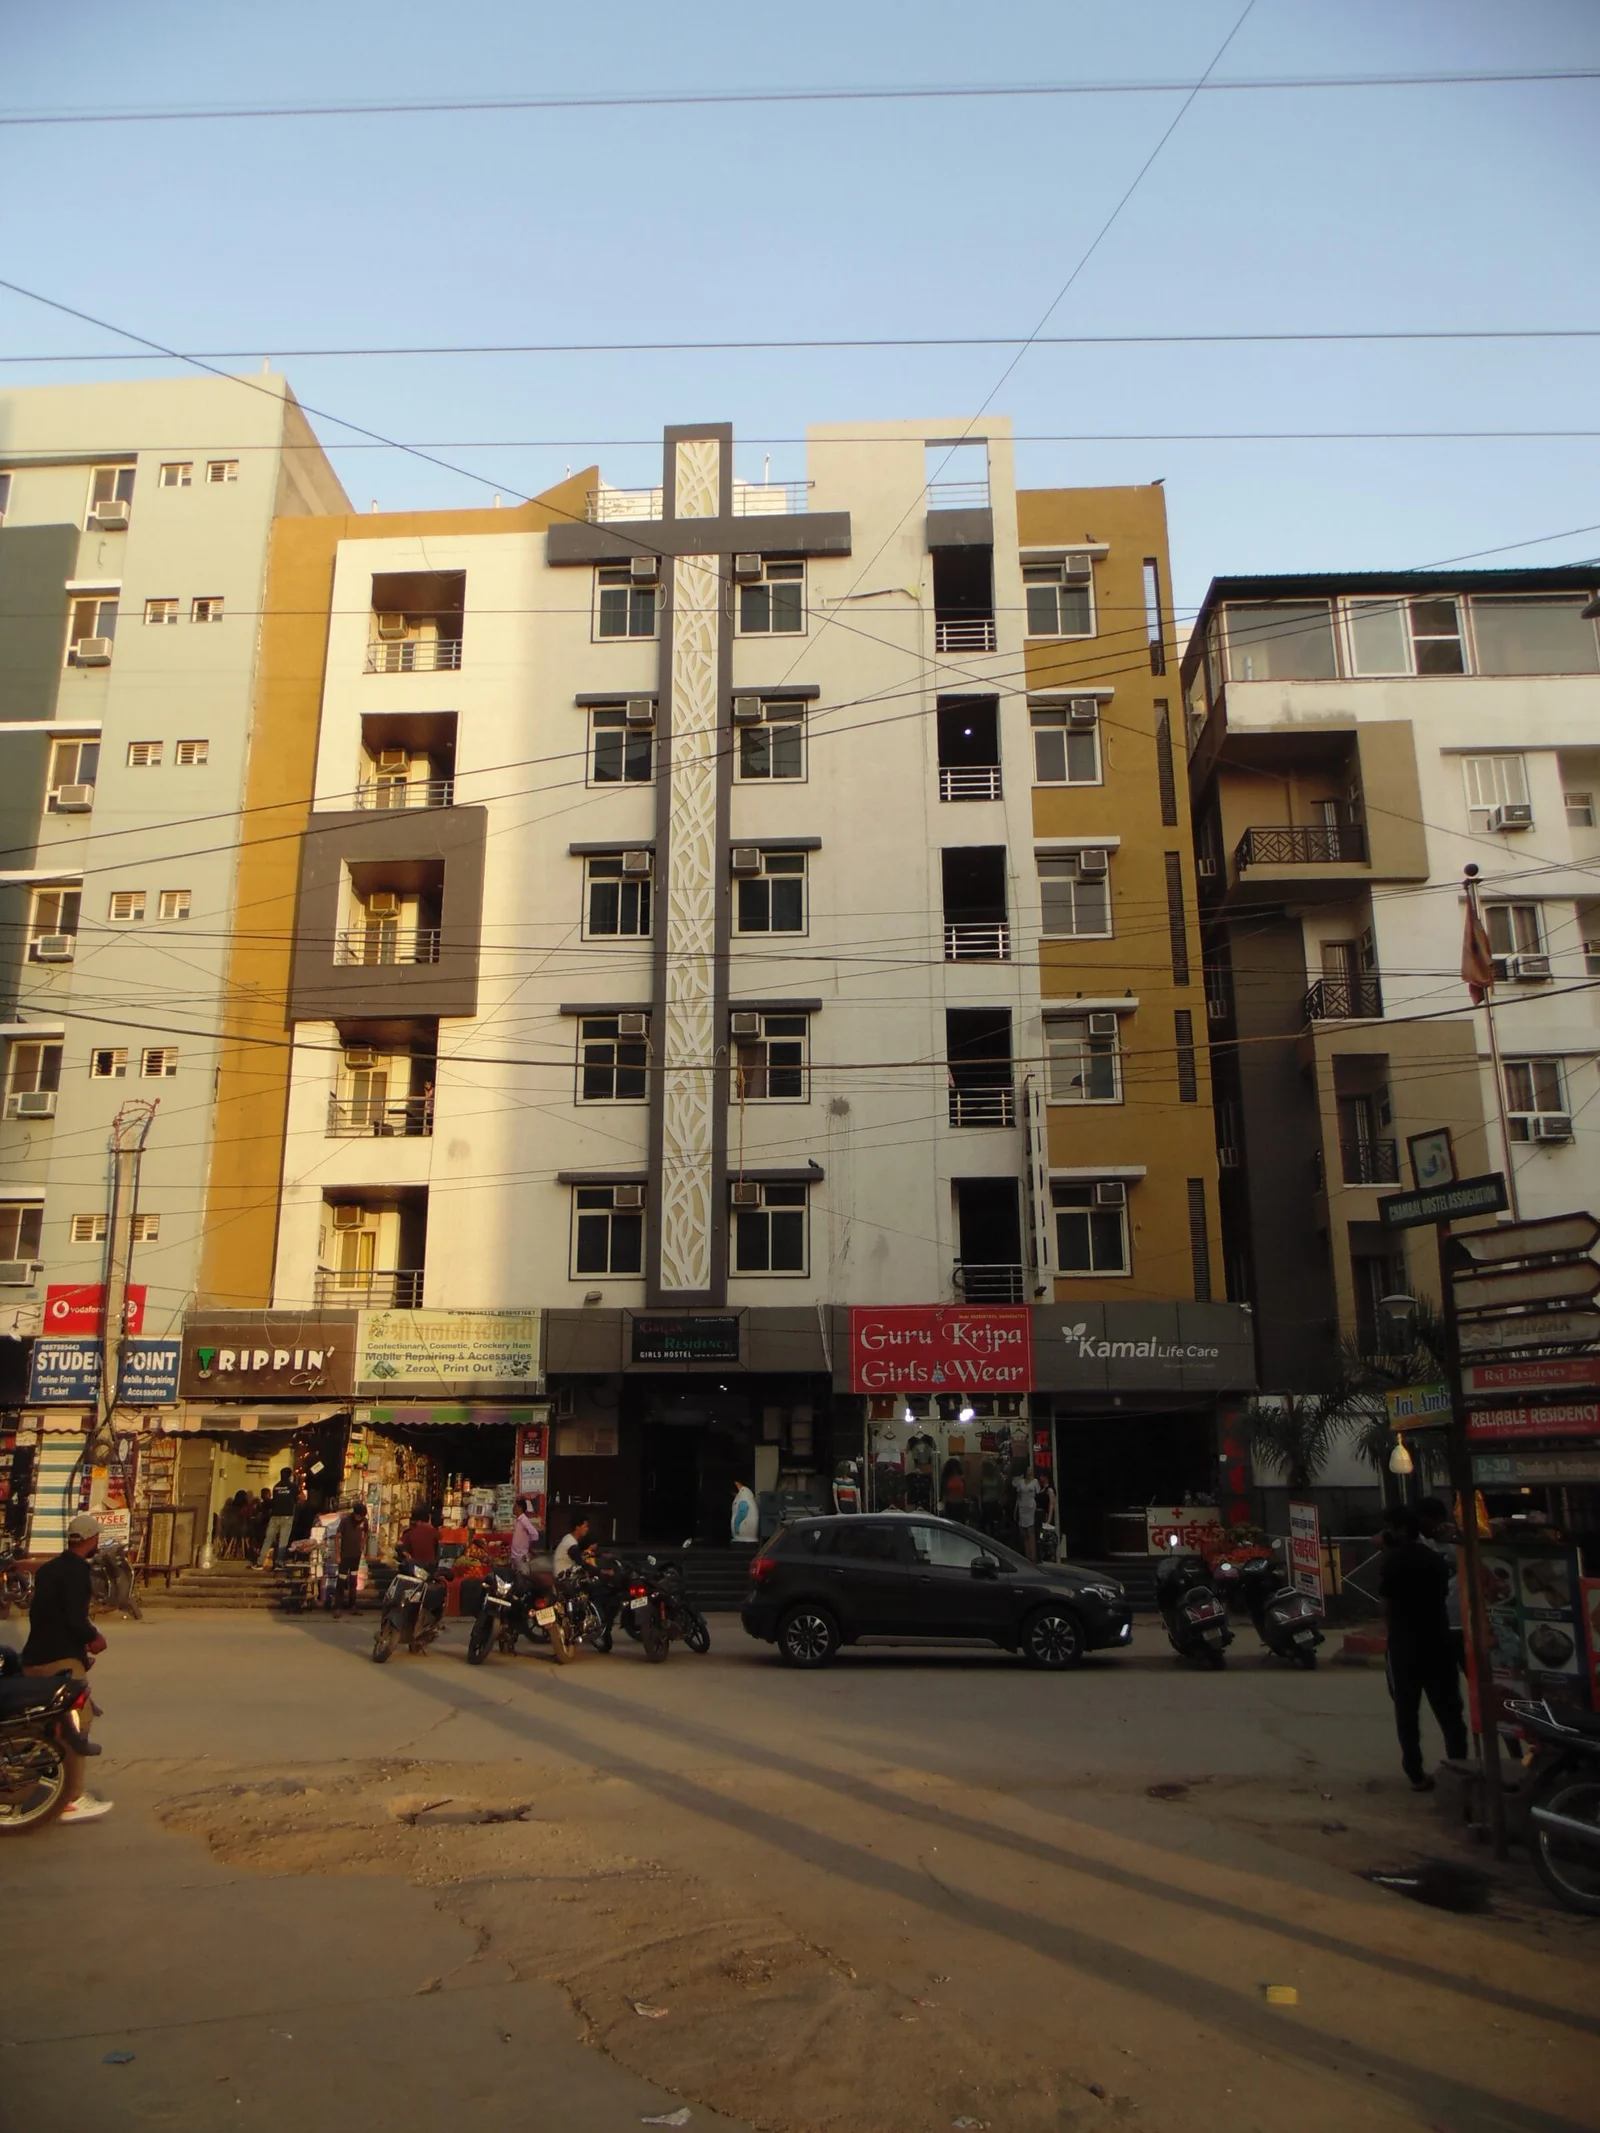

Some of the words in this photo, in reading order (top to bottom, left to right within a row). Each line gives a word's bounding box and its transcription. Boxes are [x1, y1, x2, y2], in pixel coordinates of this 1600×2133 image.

[1388, 1200, 1422, 1222] CHAMBAL
[1421, 1195, 1448, 1215] HOSTEL
[860, 1323, 934, 1351] Guru
[941, 1322, 1023, 1354] Kripa
[429, 1342, 470, 1350] Cosmetic,
[473, 1342, 510, 1351] Crockery
[512, 1342, 532, 1350] Item
[1078, 1336, 1157, 1358] Kamal
[1157, 1344, 1184, 1358] Life
[1186, 1345, 1219, 1358] Care
[37, 1351, 103, 1371] STUDEN
[365, 1352, 402, 1361] Mobile
[404, 1352, 456, 1363] Repairing
[457, 1352, 465, 1361] &
[639, 1350, 662, 1358] GIRLS
[663, 1350, 693, 1358] HOSTEL
[405, 1363, 440, 1374] Zerox,
[442, 1363, 469, 1373] Print
[472, 1363, 493, 1373] Out
[861, 1360, 928, 1387] Girls
[943, 1359, 1024, 1384] Wear
[37, 1375, 59, 1384] Online
[59, 1374, 77, 1384] Form
[144, 1374, 176, 1386] Repairing
[1484, 1369, 1505, 1383] Raj
[48, 1386, 70, 1396] Ticket
[1393, 1392, 1414, 1417] Jai
[1471, 1407, 1527, 1428] RELIABLE
[1530, 1404, 1599, 1424] RESIDENCY
